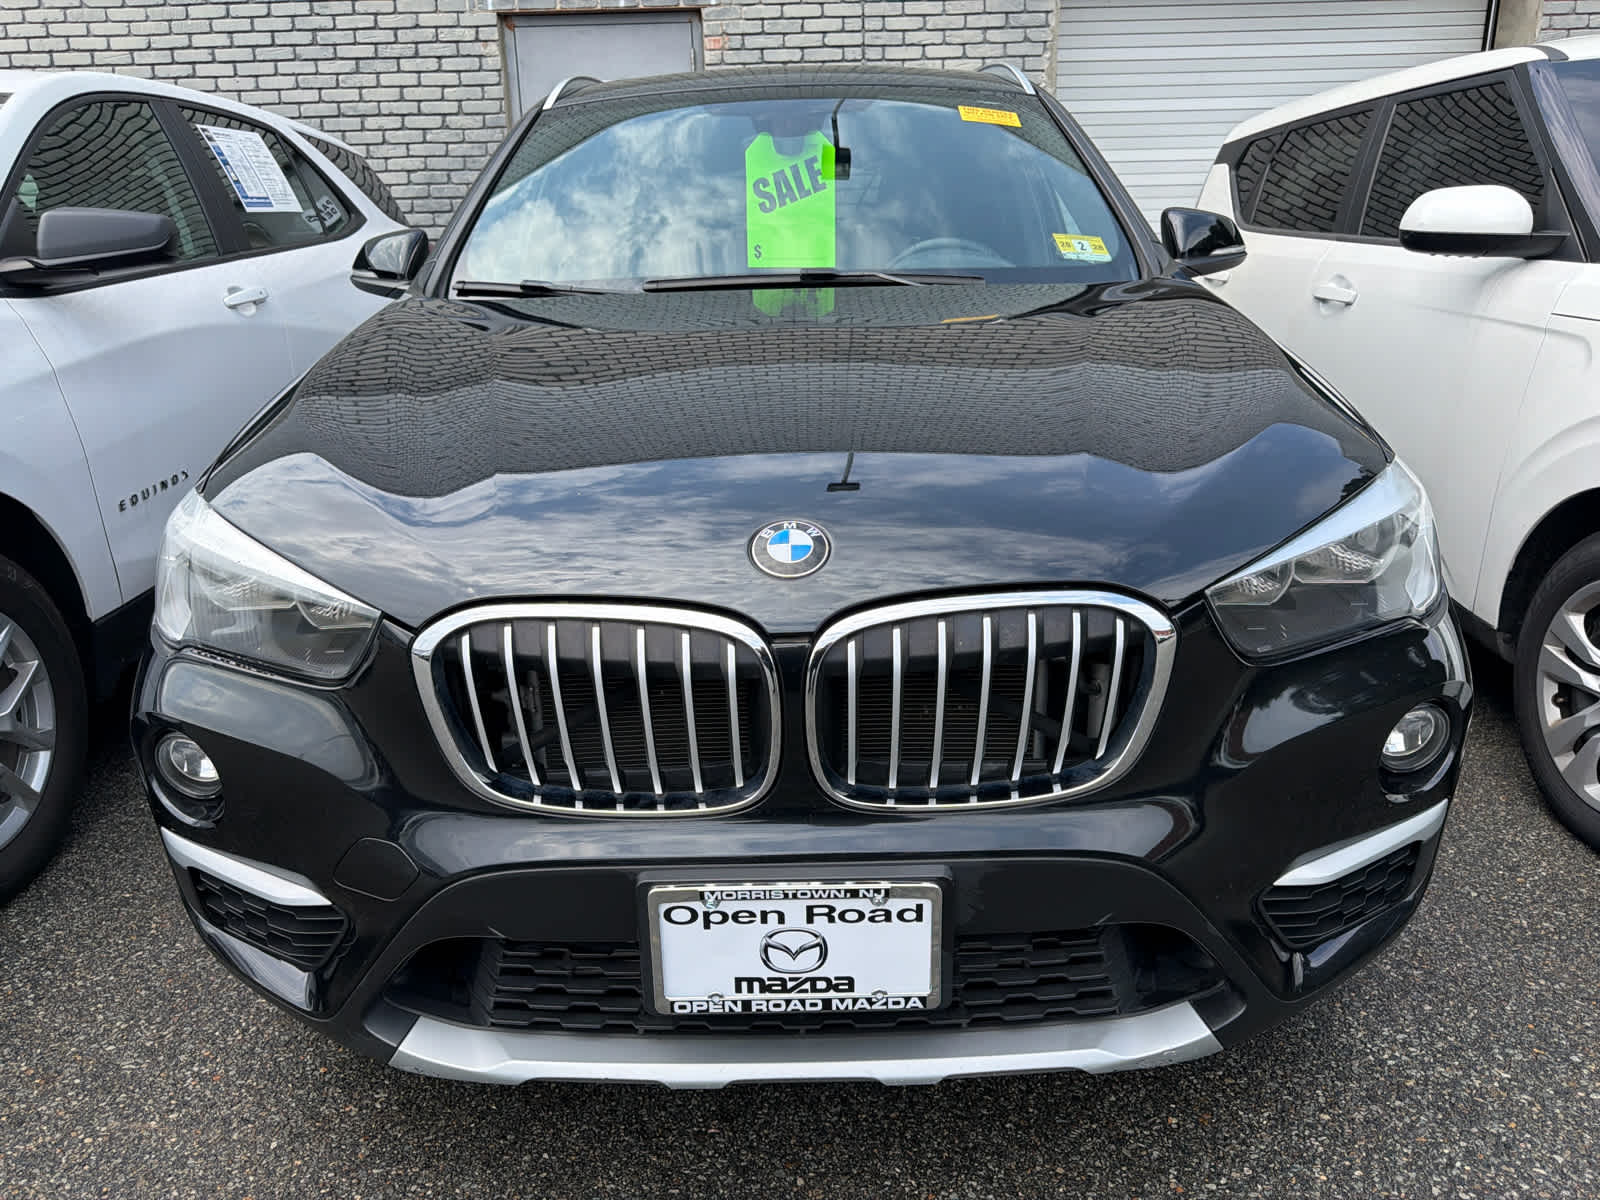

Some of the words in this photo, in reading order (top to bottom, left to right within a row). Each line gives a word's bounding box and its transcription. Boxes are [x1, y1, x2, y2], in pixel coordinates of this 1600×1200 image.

[752, 155, 828, 214] SALE
[754, 244, 762, 259] $
[1077, 241, 1087, 251] 2
[760, 521, 821, 539] BMW
[703, 889, 850, 900] MORRISTOWN,
[859, 888, 886, 899] NJ
[663, 905, 786, 930] Open
[805, 903, 924, 925] Road
[734, 976, 855, 994] mazda
[673, 999, 742, 1013] OPEN
[751, 999, 823, 1013] ROAD
[831, 997, 924, 1012] MAZDA
